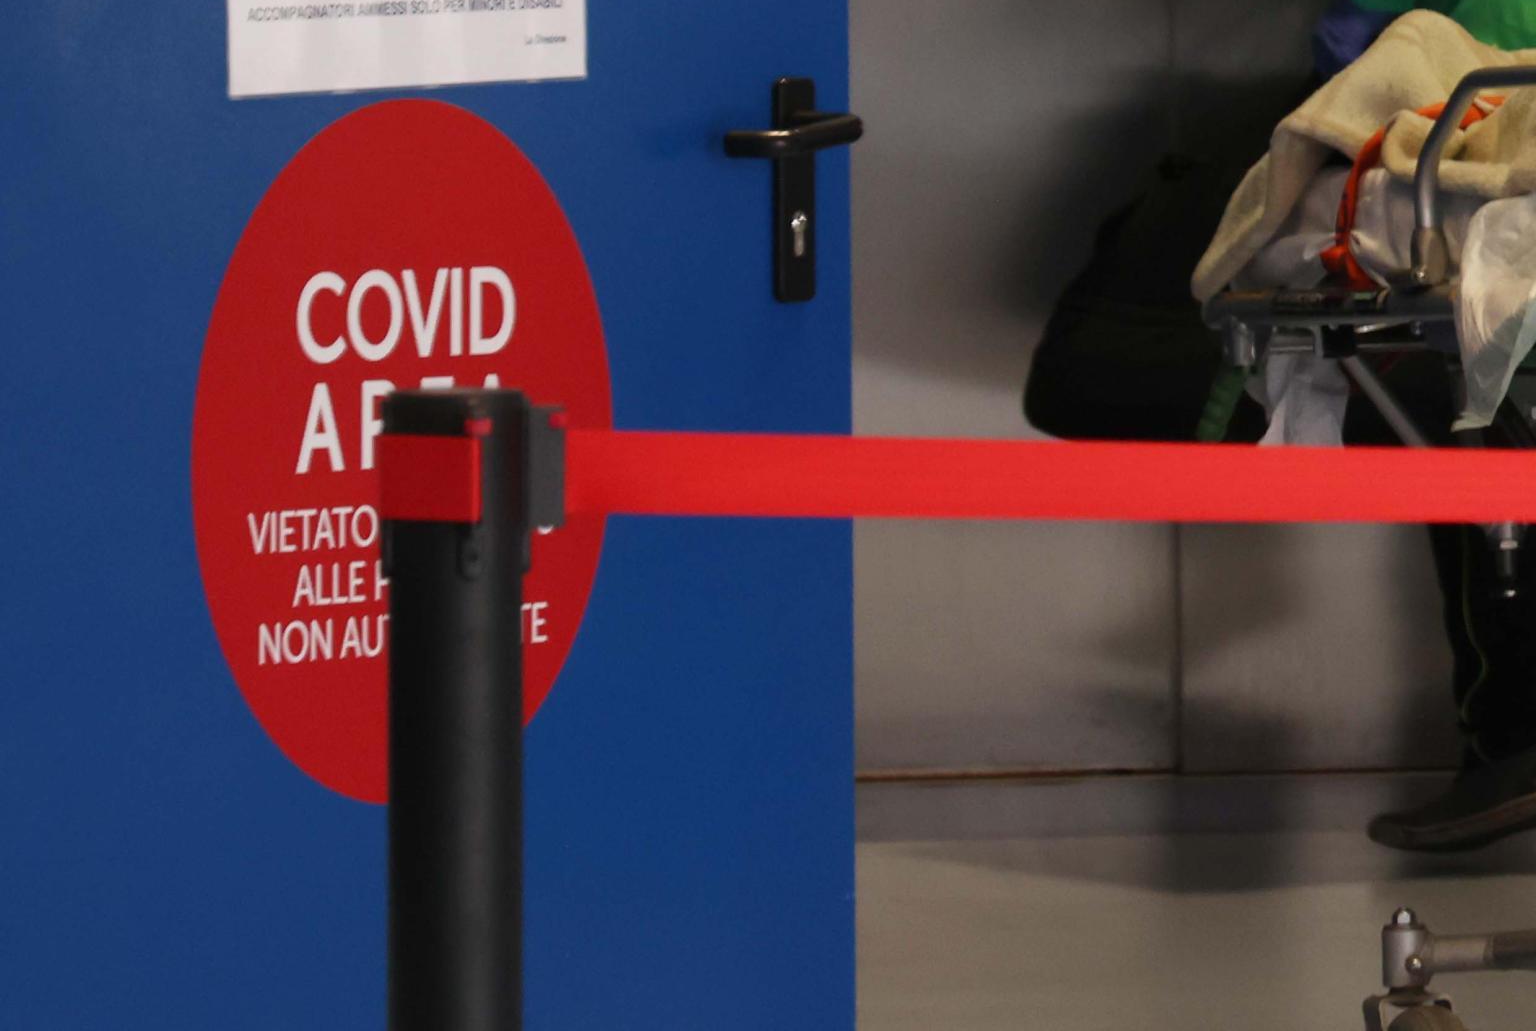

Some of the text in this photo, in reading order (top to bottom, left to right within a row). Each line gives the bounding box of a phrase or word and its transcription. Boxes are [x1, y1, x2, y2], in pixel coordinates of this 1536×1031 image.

[247, 3, 354, 22] ACCOMPAGNATORI
[410, 0, 442, 15] SOLO
[296, 265, 517, 364] COVID
[247, 504, 379, 555] VIETATO
[292, 560, 367, 608] ALLE
[258, 618, 333, 666] NON
